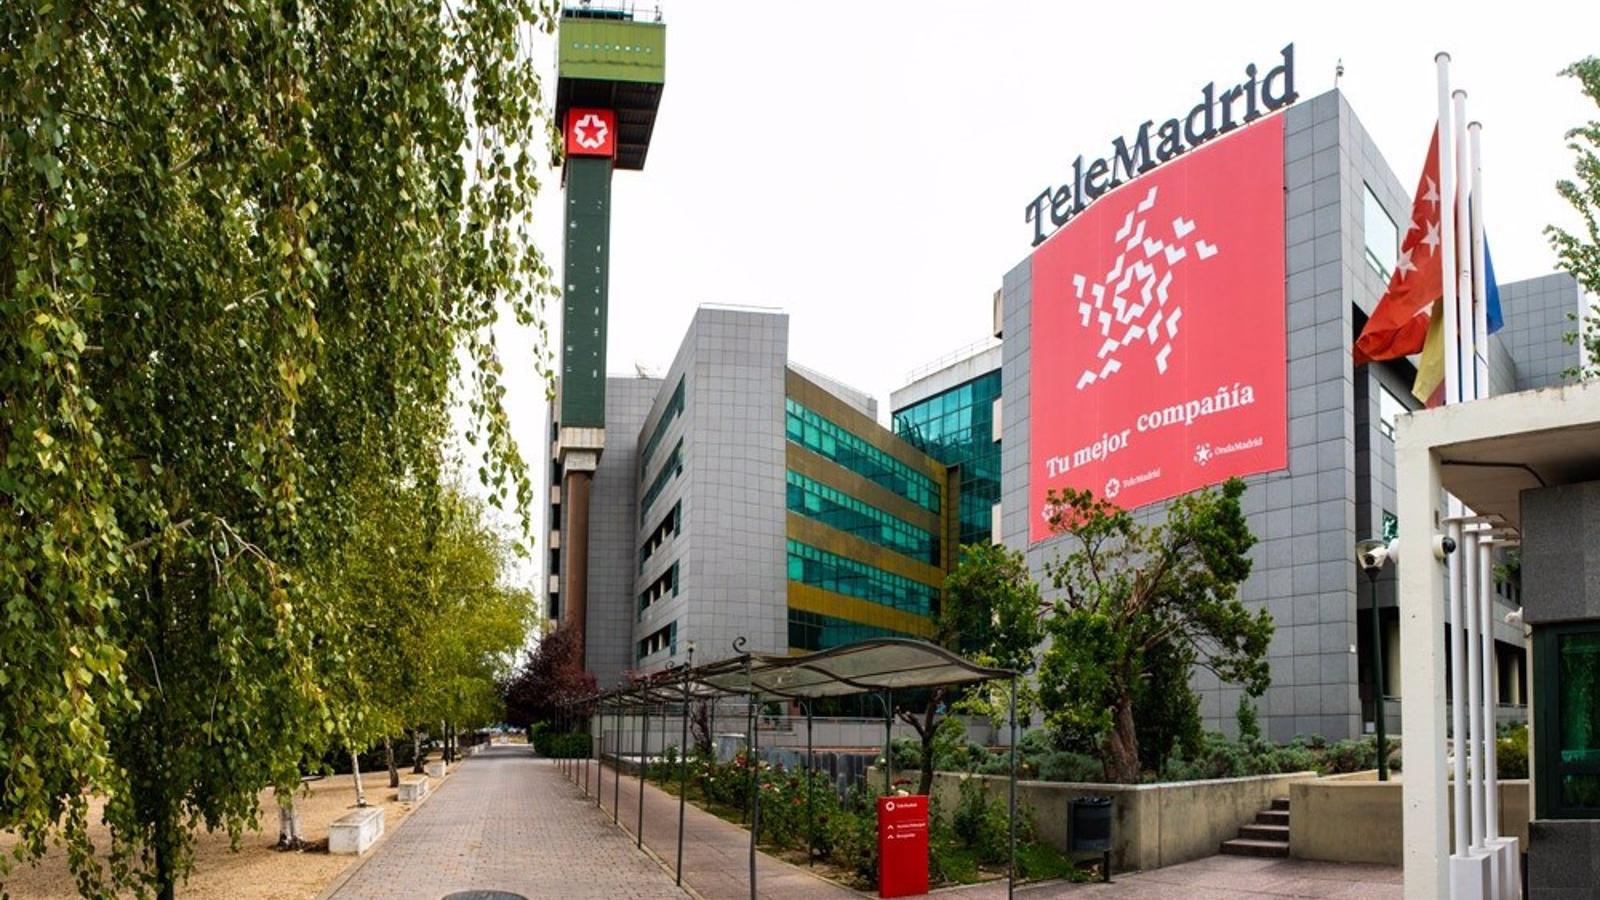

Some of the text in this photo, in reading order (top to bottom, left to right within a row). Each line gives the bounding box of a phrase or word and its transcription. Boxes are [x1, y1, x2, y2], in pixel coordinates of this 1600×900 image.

[1025, 42, 1299, 247] TeleMadrid
[1046, 382, 1255, 478] Tu mejor compañía
[1214, 436, 1263, 456] OndaMadrid
